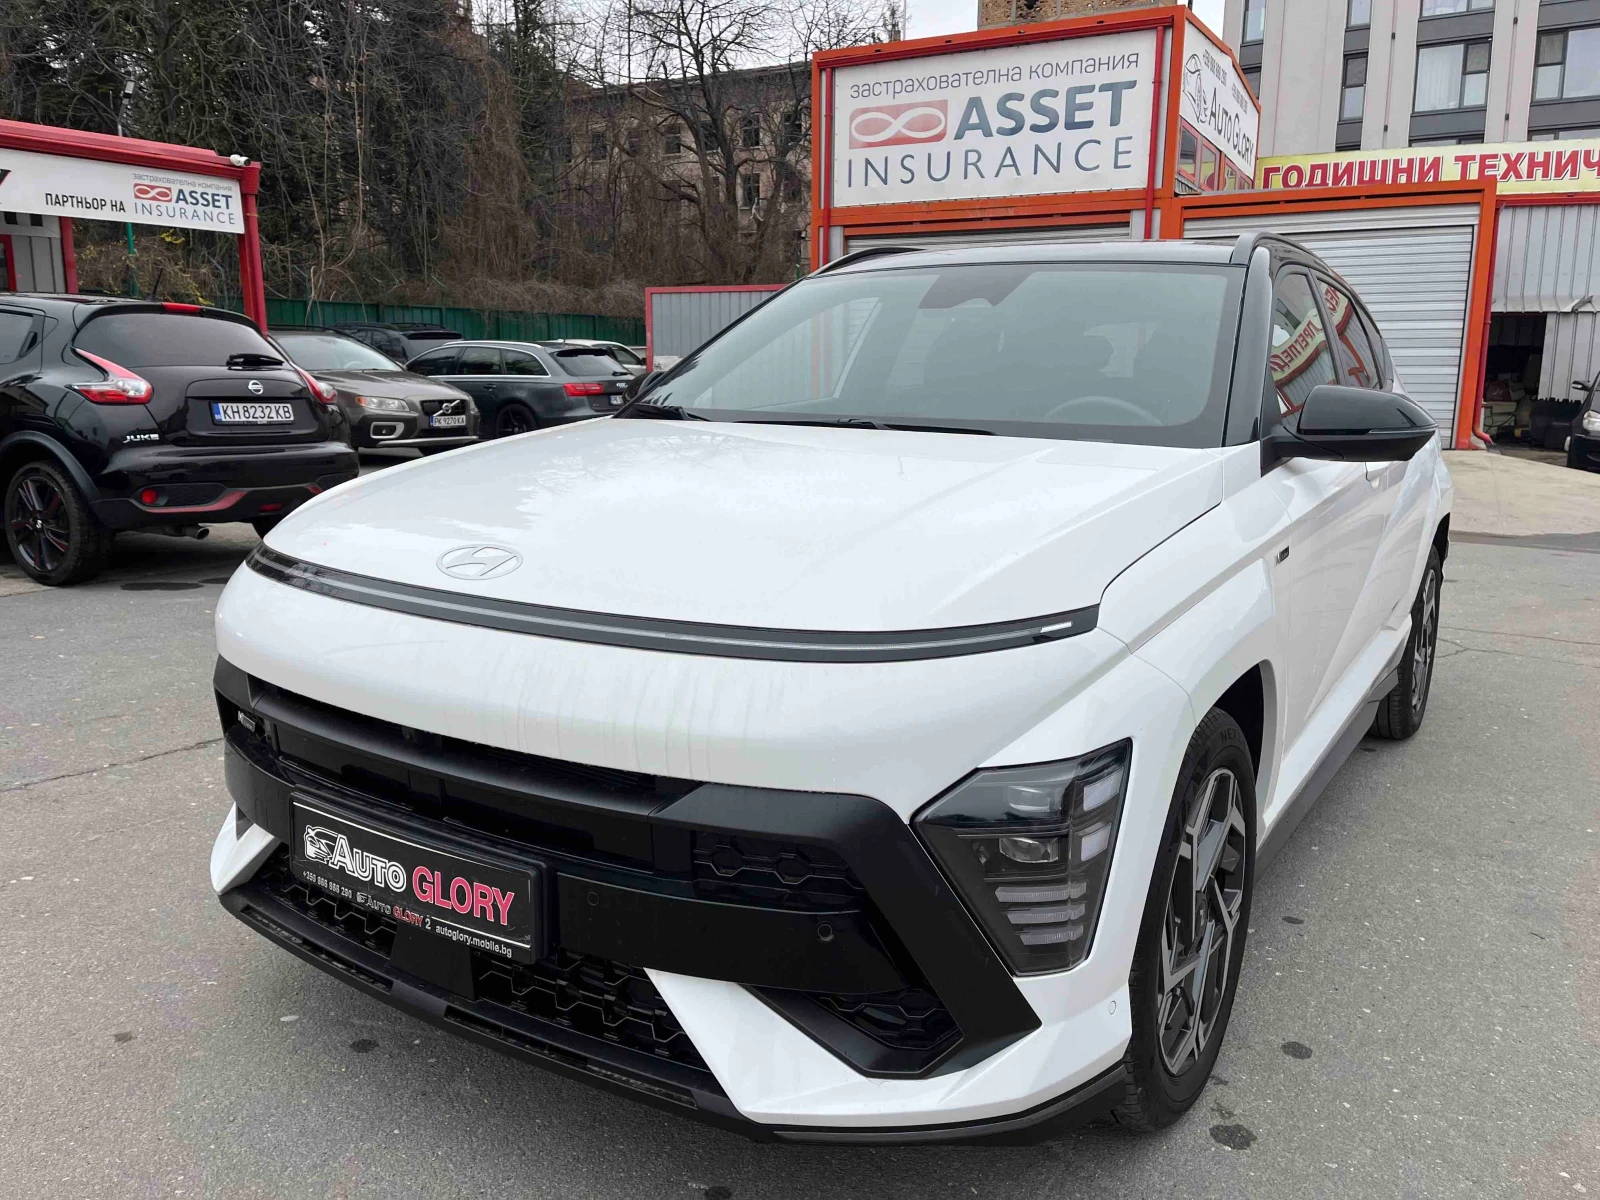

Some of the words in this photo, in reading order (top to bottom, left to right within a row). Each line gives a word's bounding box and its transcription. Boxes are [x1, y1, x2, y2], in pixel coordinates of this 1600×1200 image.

[849, 63, 1022, 100] застрахователна
[1029, 52, 1140, 81] компания
[953, 79, 1137, 141] ASSET
[848, 135, 1133, 188] INSURANCE
[1262, 156, 1442, 190] ГОДИШНИ
[132, 172, 197, 188] застрахователна
[197, 182, 233, 192] компания
[175, 188, 233, 210] ASSET
[45, 192, 107, 211] ПАРТНЬОР
[110, 199, 126, 213] НА
[134, 202, 236, 225] INSURANCE
[122, 433, 160, 444] JUKE
[328, 833, 407, 893] AUTO
[412, 865, 515, 926] GLORY
[365, 895, 392, 915] AUTO
[392, 905, 424, 928] GLORY
[425, 918, 431, 930] 2
[435, 925, 512, 959] autoglory.mobile.bg
